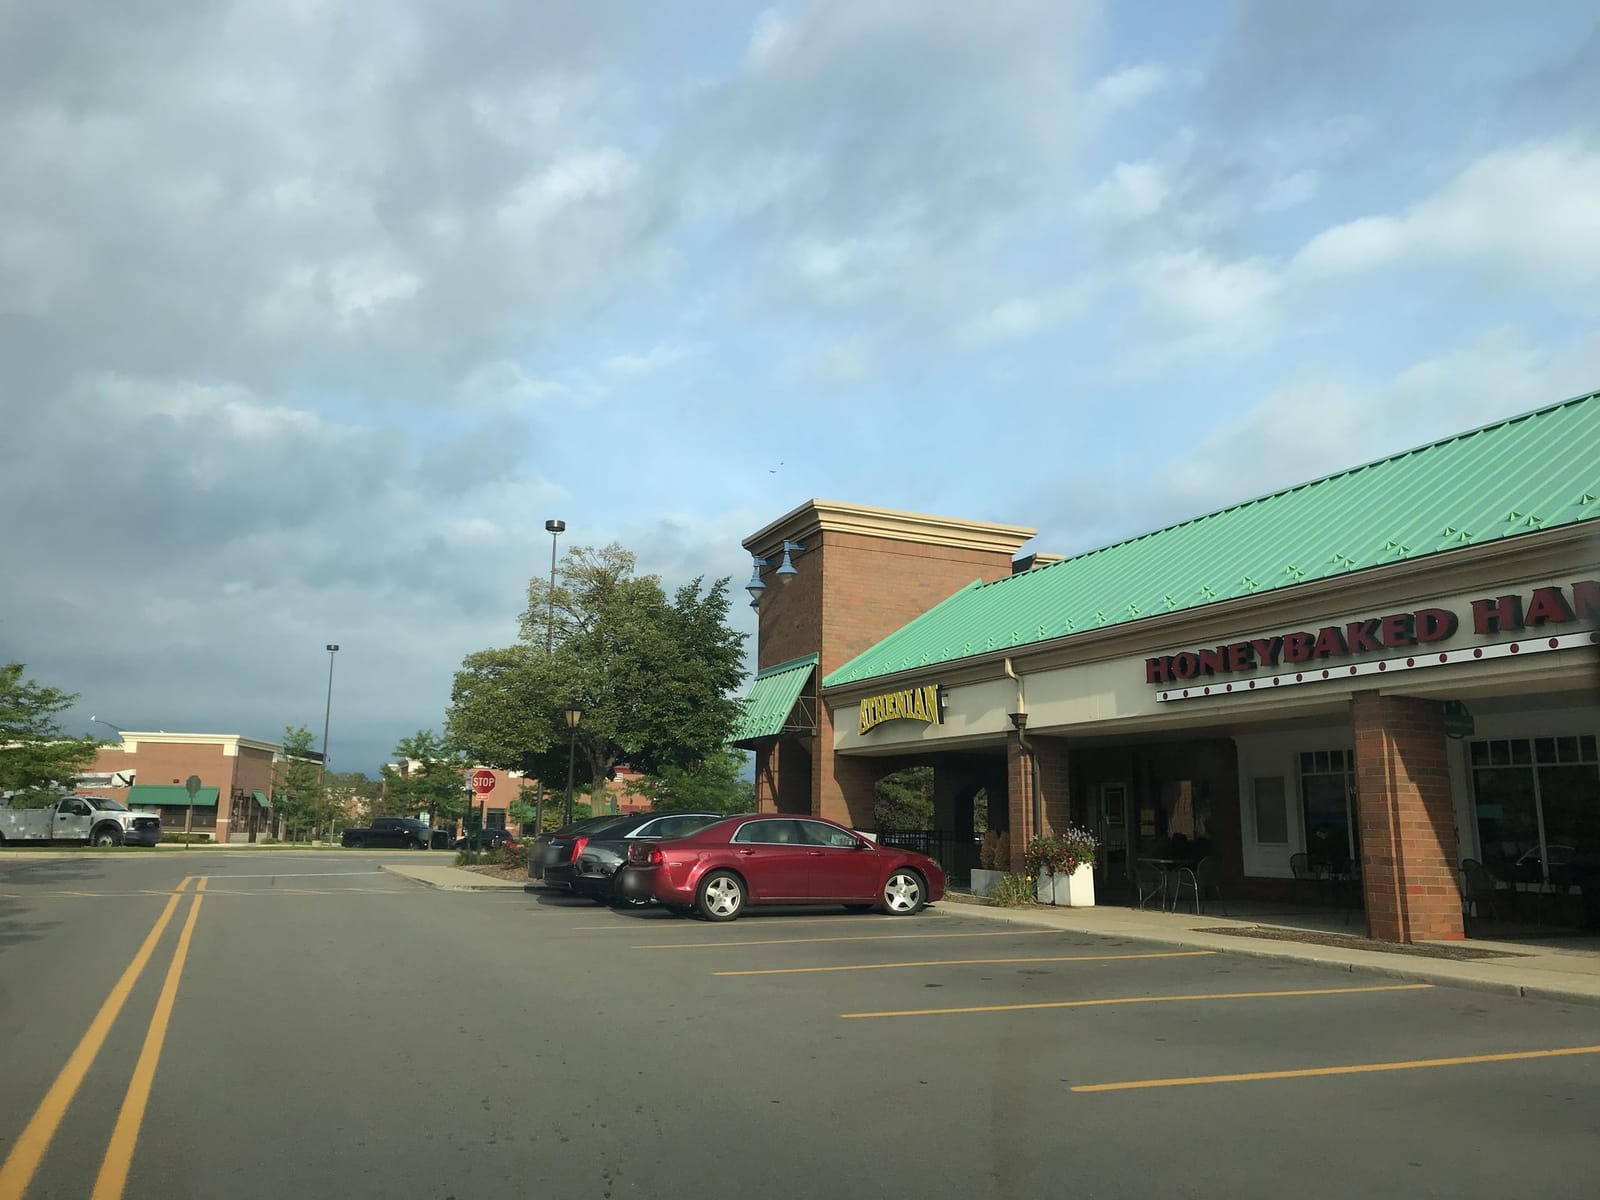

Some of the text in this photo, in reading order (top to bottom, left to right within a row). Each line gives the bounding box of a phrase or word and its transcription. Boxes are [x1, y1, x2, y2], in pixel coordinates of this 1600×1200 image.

[1145, 608, 1458, 684] HONEYBAKED
[858, 684, 942, 735] ATHENIAN
[473, 777, 495, 787] STOP
